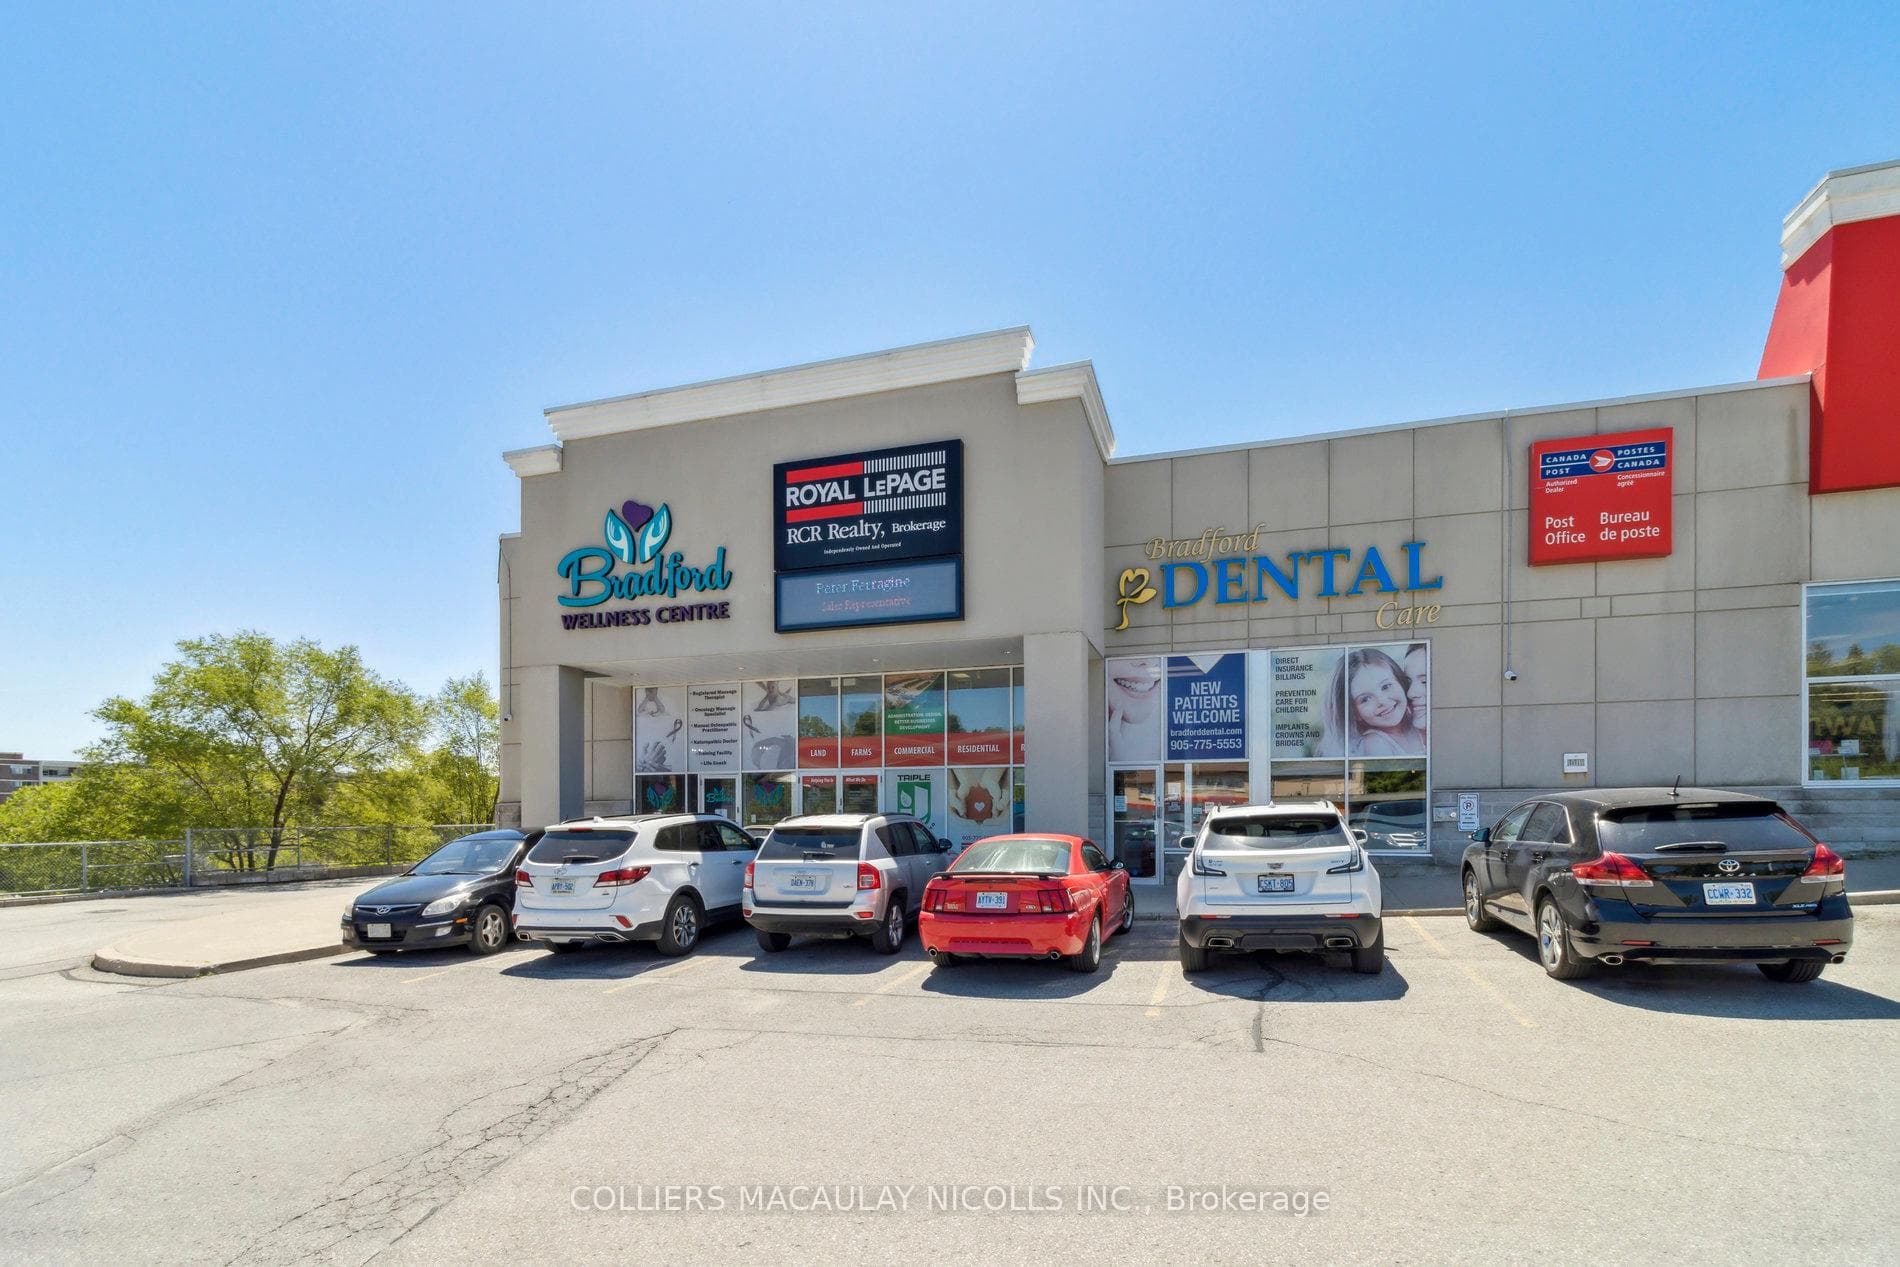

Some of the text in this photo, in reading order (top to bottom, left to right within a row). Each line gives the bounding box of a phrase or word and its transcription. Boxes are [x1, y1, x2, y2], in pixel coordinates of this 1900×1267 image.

[1617, 446, 1655, 456] POSTES
[1545, 453, 1587, 464] CANADA
[1617, 458, 1660, 469] CANADA
[1545, 467, 1571, 476] POST
[1617, 470, 1665, 481] Concessionnaire
[1545, 478, 1578, 487] Authorized
[786, 479, 855, 507] ROYAL
[1545, 515, 1575, 529] Post
[1600, 511, 1650, 525] Bureau
[786, 519, 946, 544] RCR Realty, Brokerage
[1545, 530, 1586, 545] Office
[1600, 525, 1660, 542] de poste
[1145, 521, 1267, 563] Bradford
[824, 546, 854, 554] Independently
[557, 545, 733, 607] Bradford
[1160, 540, 1444, 610] DENTAL
[561, 601, 730, 630] WELLNESS CENTRE
[1375, 599, 1442, 630] Care
[1275, 664, 1313, 672] INSURANCE
[1190, 681, 1222, 695] NEW
[1275, 689, 1317, 697] PREVENTION
[1174, 694, 1238, 710] PATIENTS
[1172, 709, 1240, 724] WELCOME
[1170, 727, 1243, 737] bradforddental.com
[1275, 730, 1320, 739] CROWNS AND
[810, 744, 1000, 757] LAND FARMS COMMERCIAL RESIDENTIAL
[1170, 738, 1243, 750] 905-775-5553
